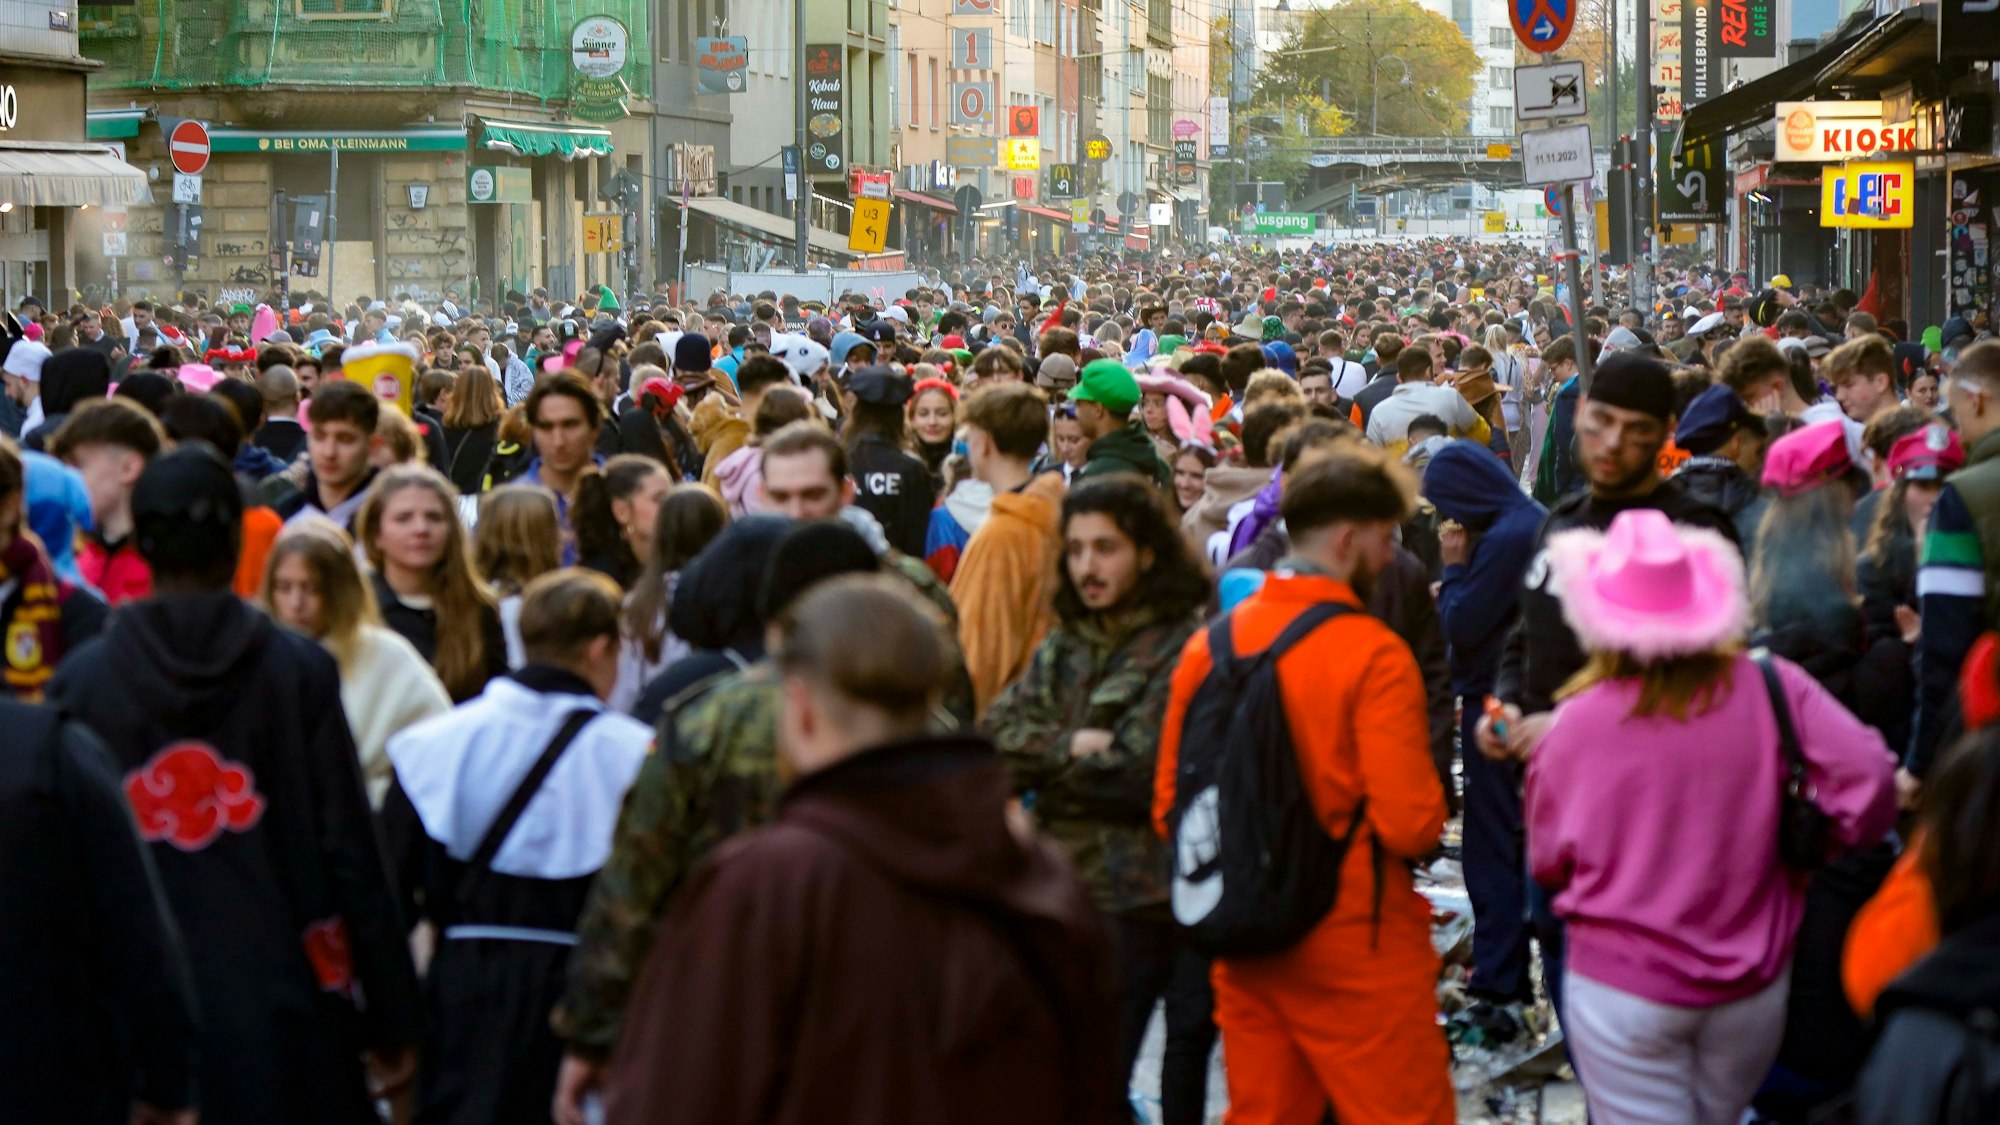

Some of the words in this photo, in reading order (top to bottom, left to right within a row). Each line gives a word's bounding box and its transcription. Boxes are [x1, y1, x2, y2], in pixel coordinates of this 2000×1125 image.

[1695, 6, 1708, 98] HILLEBRAND
[808, 78, 840, 94] Kebab
[811, 97, 839, 111] Haus
[274, 138, 294, 149] BEI
[298, 138, 329, 149] OMA
[331, 138, 408, 149] KLEINMANN
[1823, 128, 1917, 152] KIOSK
[1535, 150, 1578, 164] 11.11.2023
[863, 208, 879, 220] U3
